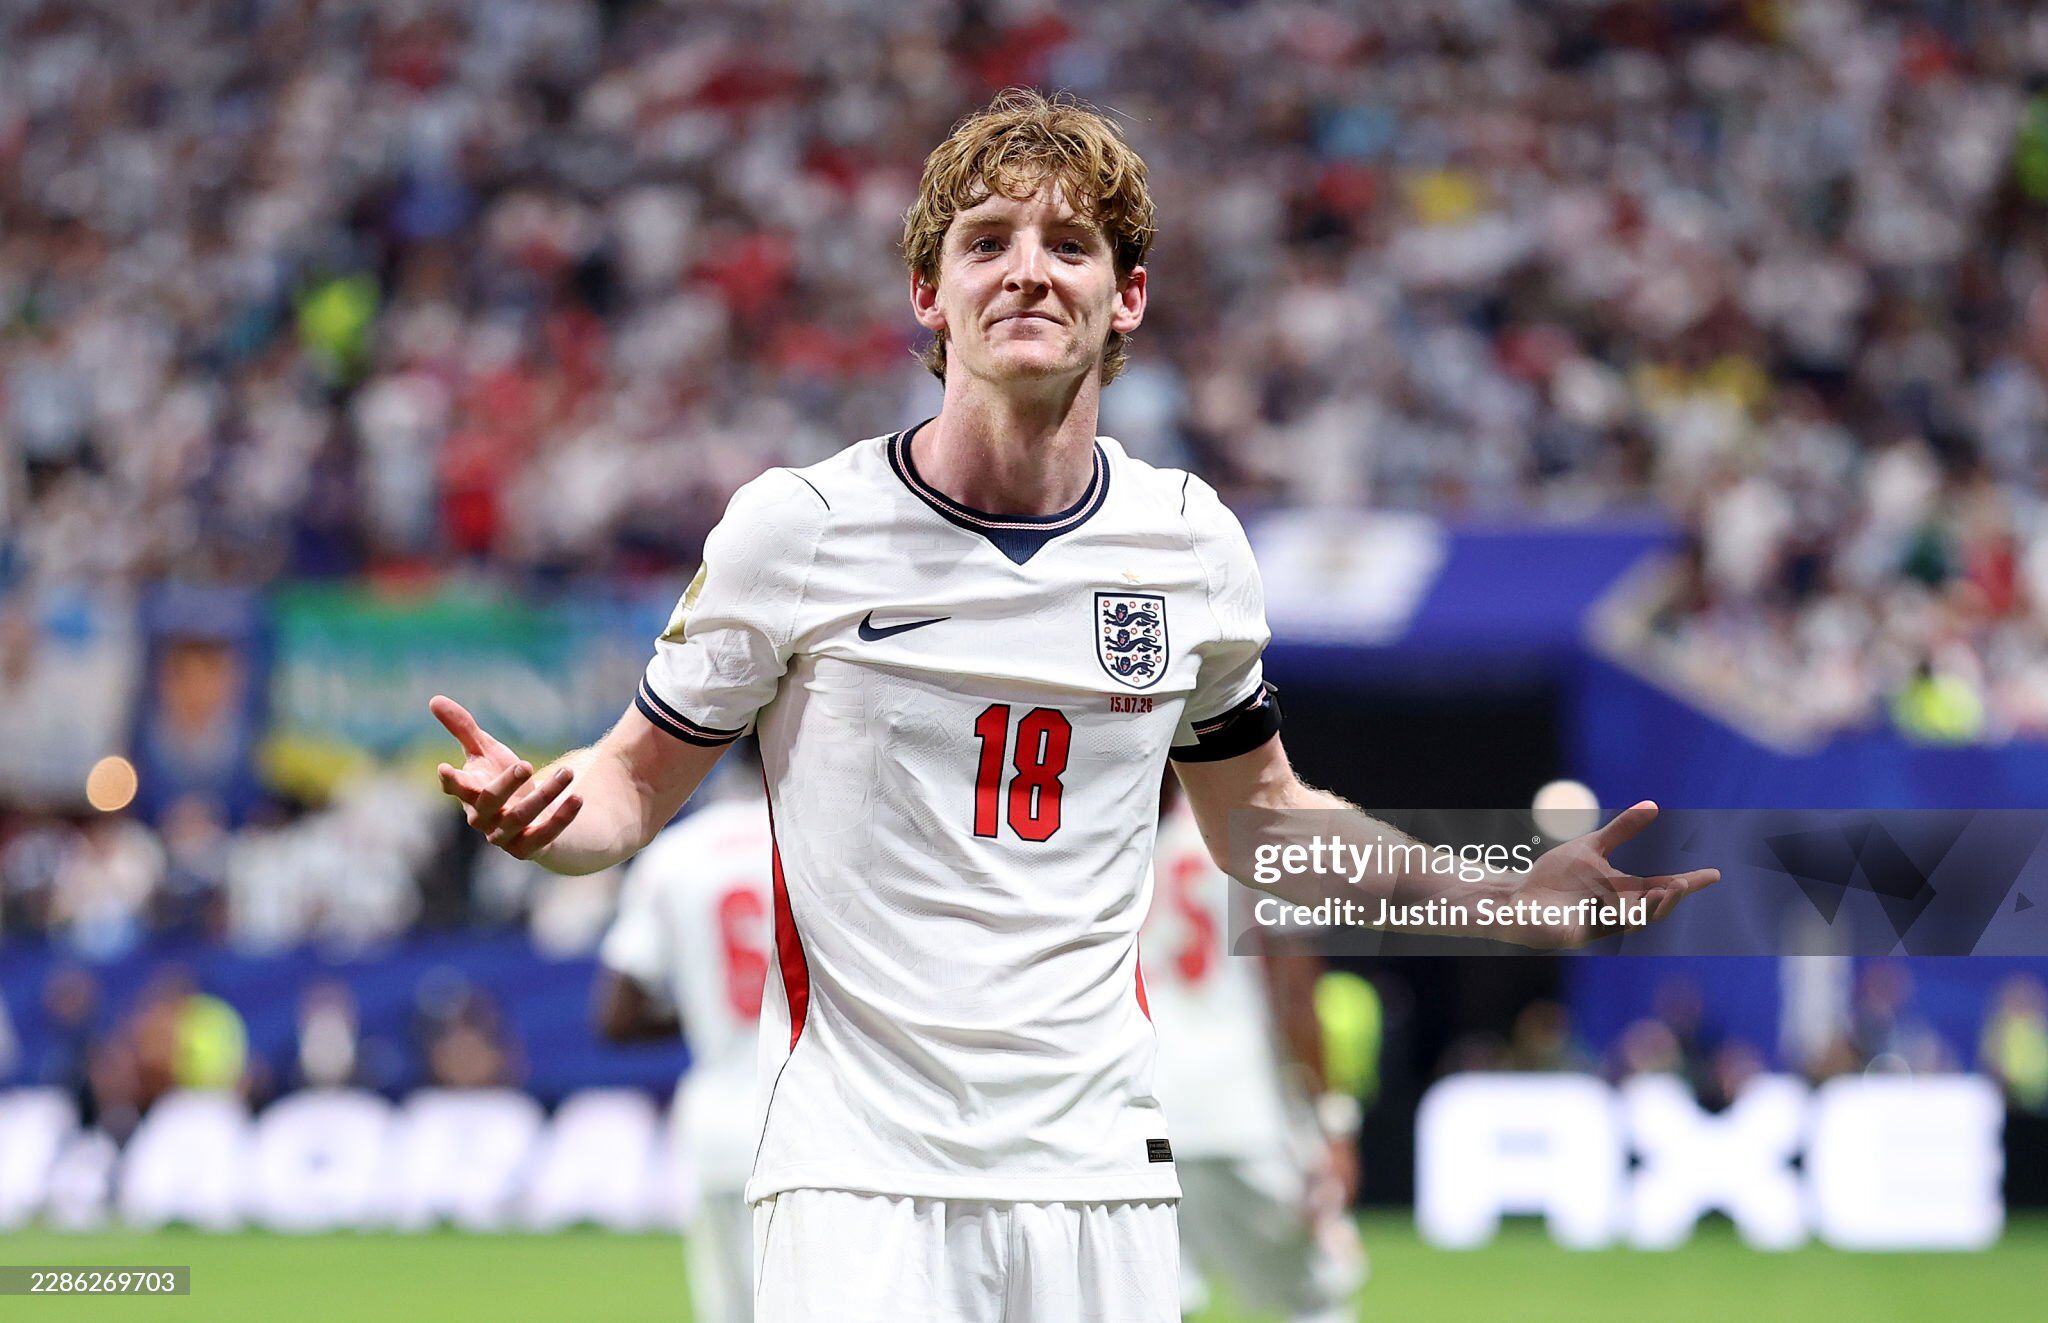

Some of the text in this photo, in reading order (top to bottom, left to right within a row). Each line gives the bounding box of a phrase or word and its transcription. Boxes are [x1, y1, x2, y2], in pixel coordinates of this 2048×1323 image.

[974, 703, 1072, 842] 18
[1110, 697, 1153, 713] 15.07.26
[1417, 1072, 2003, 1251] AXE
